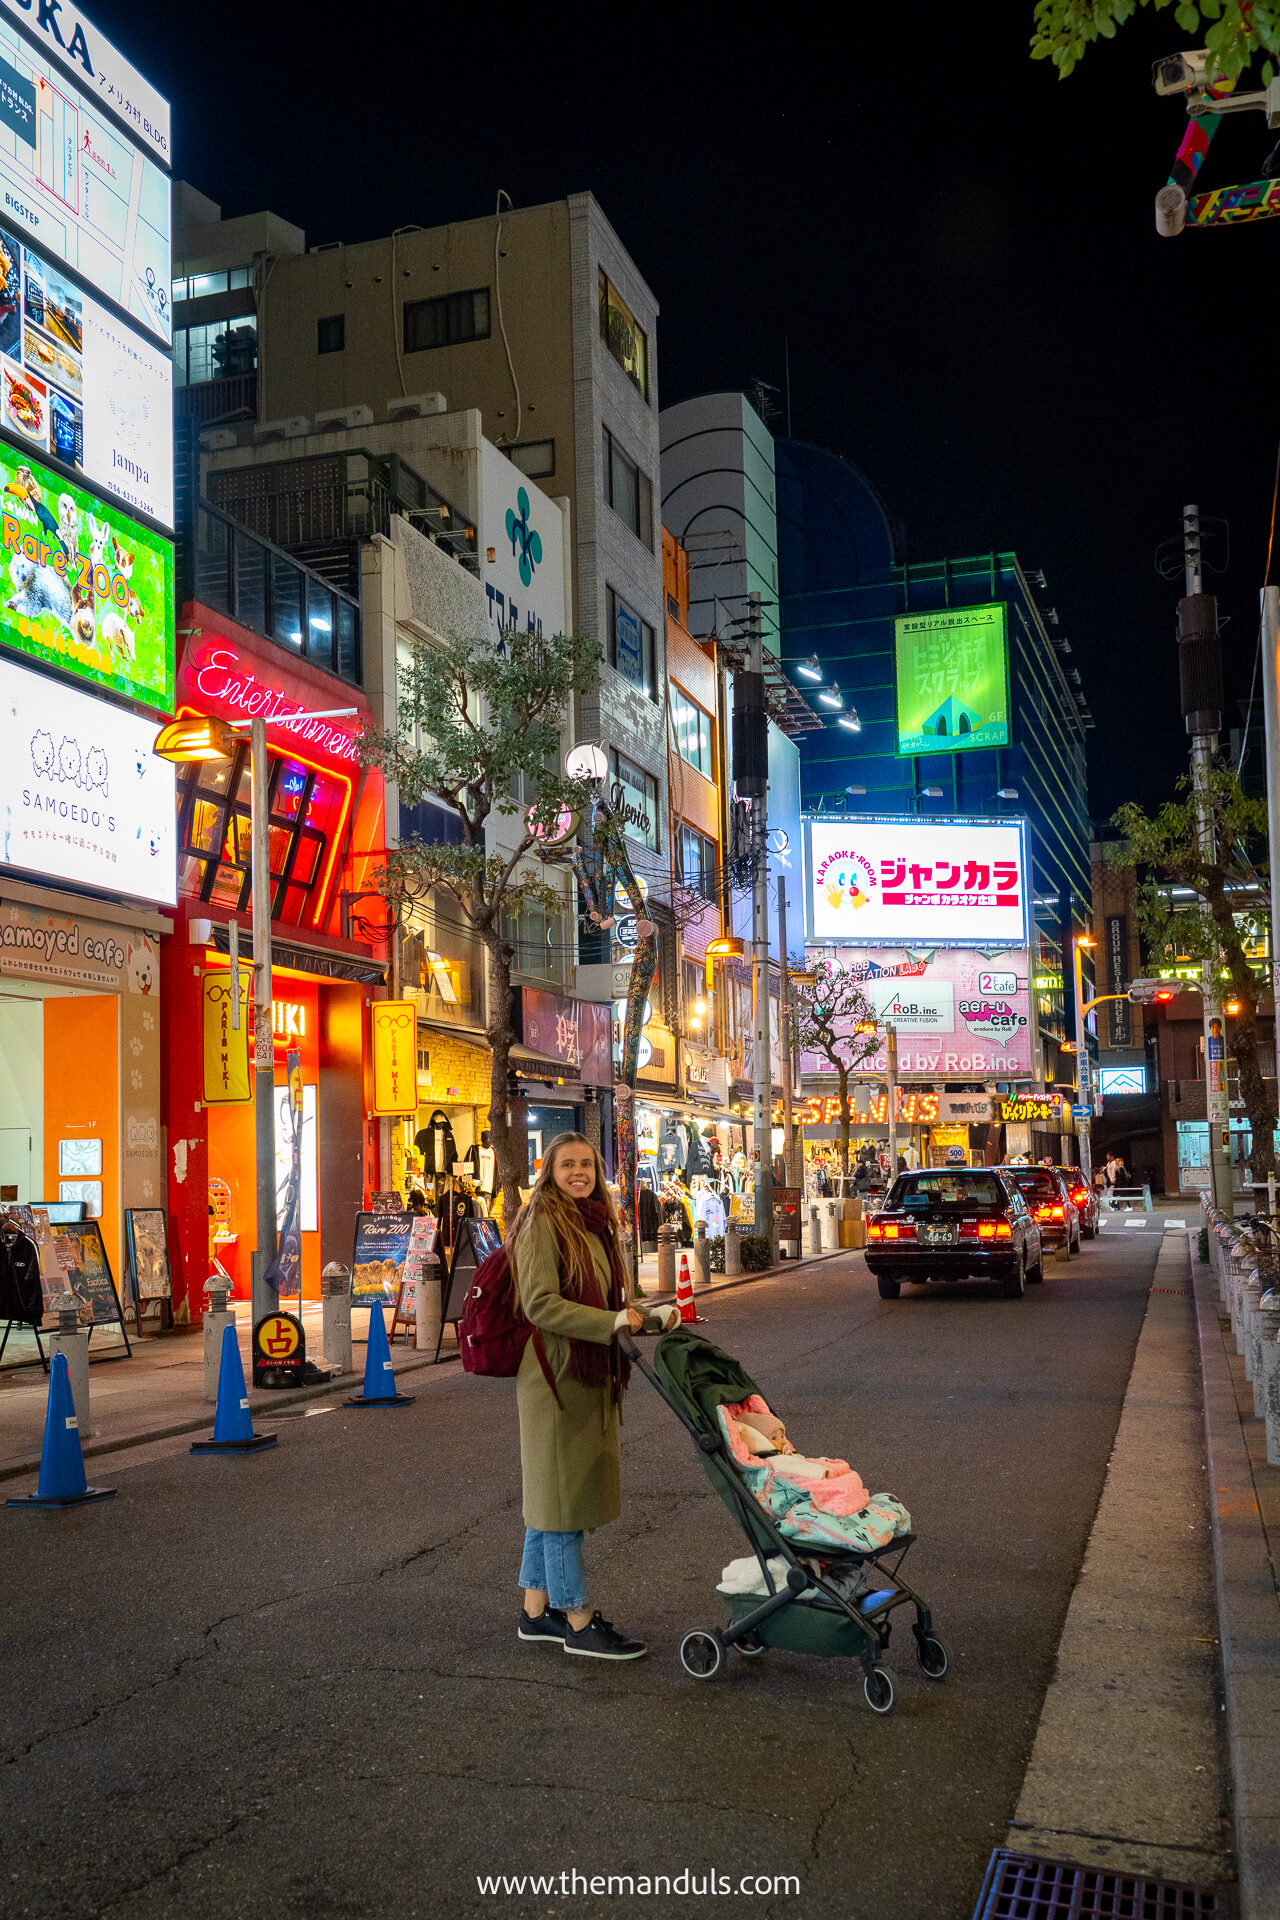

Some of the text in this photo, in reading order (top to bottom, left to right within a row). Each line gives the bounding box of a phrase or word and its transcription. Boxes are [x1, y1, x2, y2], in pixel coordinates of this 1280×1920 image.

[99, 71, 169, 153] アメリカ村 BLDG.
[5, 192, 40, 226] BIGSTEP
[112, 448, 150, 484] Jampa
[2, 510, 68, 578] Rare
[988, 710, 1003, 723] 6F
[969, 731, 1005, 743] SCRAP
[22, 789, 116, 832] SAMOEDO'S
[880, 857, 1018, 891] ジャンカラ
[1111, 919, 1120, 955] GROUP
[83, 937, 125, 969] cafe
[993, 980, 1015, 992] cafe
[892, 1003, 938, 1015] RoB.inc
[959, 1000, 1007, 1014] aer-u
[990, 1012, 1028, 1026] cafe
[221, 1052, 230, 1090] MIKI
[815, 1052, 1020, 1071] Producd by RoB.inc
[1079, 1050, 1089, 1090] 歩車分離式
[391, 1071, 399, 1102] MIKI
[87, 1120, 97, 1128] 1F
[949, 1149, 963, 1157] 500
[386, 1223, 410, 1235] ZOO
[266, 1319, 292, 1354] 占
